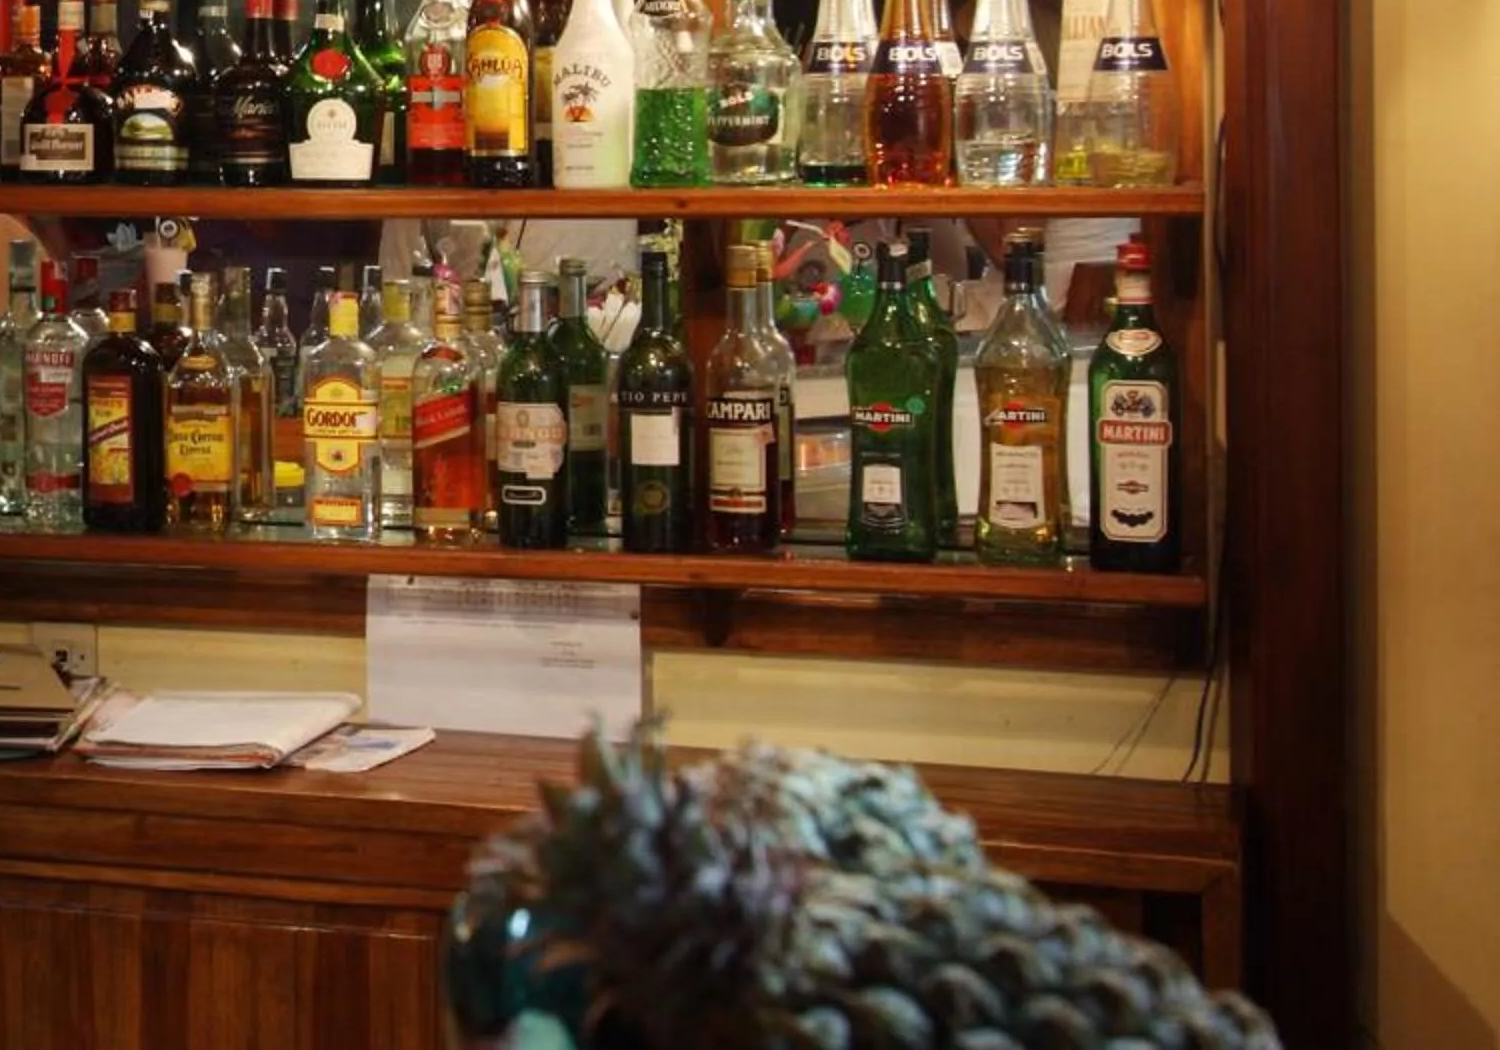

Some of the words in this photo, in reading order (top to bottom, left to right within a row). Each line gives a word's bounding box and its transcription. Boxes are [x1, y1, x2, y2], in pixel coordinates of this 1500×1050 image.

[818, 46, 866, 62] BOLS
[888, 46, 937, 62] BOLS
[972, 45, 1024, 61] BOLS
[1101, 42, 1154, 59] BOLS
[553, 63, 612, 88] MALIBU
[308, 407, 366, 427] GORDO
[707, 401, 771, 420] CAMPARI
[855, 410, 911, 423] MARTINI
[998, 410, 1046, 422] ARTINI
[1102, 425, 1167, 442] MARTINI
